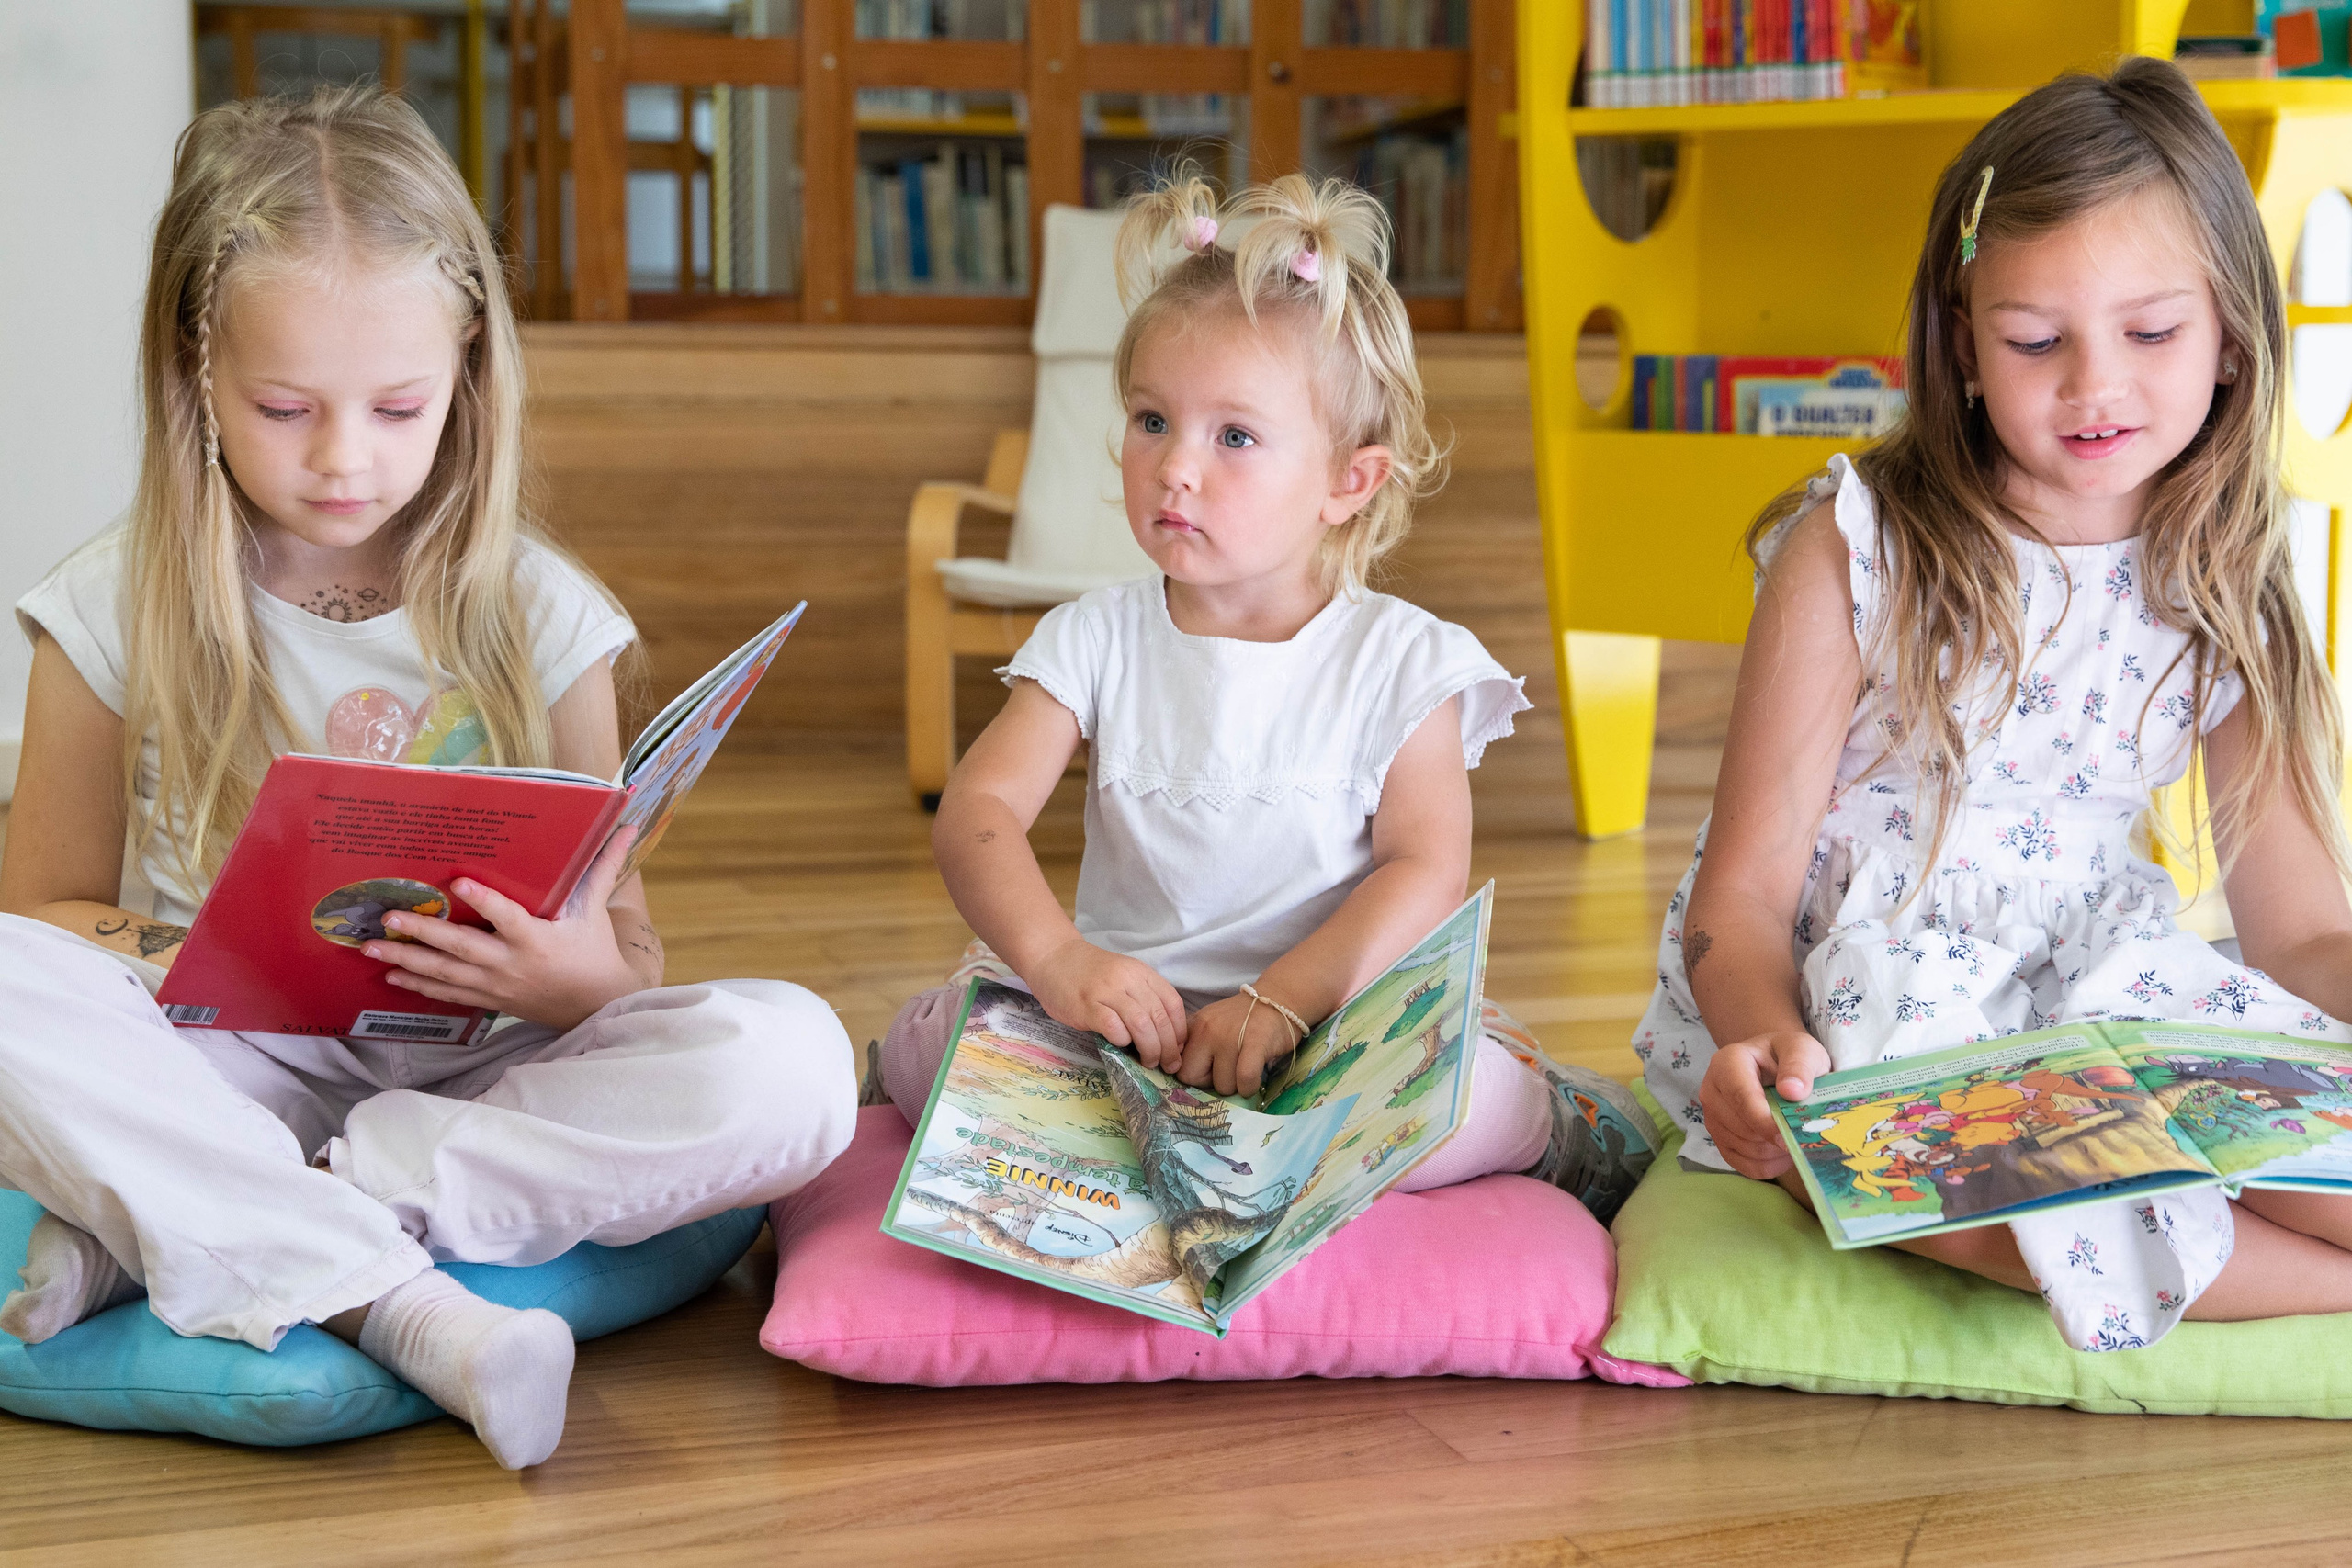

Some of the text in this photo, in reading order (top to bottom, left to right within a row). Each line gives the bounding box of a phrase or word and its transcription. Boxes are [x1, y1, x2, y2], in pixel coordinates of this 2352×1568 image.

[317, 794, 356, 804] Naquela
[409, 803, 449, 812] armário
[503, 811, 537, 820] Winnie
[402, 819, 439, 829] barriga
[442, 822, 466, 830] dava
[468, 825, 500, 833] horas!
[481, 818, 505, 826] fome
[333, 821, 365, 830] decide
[396, 828, 425, 836] partir
[447, 831, 473, 840] busca
[343, 831, 389, 840] imaginar
[403, 837, 445, 845] incríveis
[447, 840, 495, 850] aventuras
[346, 848, 382, 857] Bosque
[404, 852, 427, 861] Cem
[463, 850, 497, 859] amigos
[279, 1022, 350, 1036] SALVAT
[956, 1126, 1121, 1189] tempestade
[983, 1156, 1121, 1211] WINNIE
